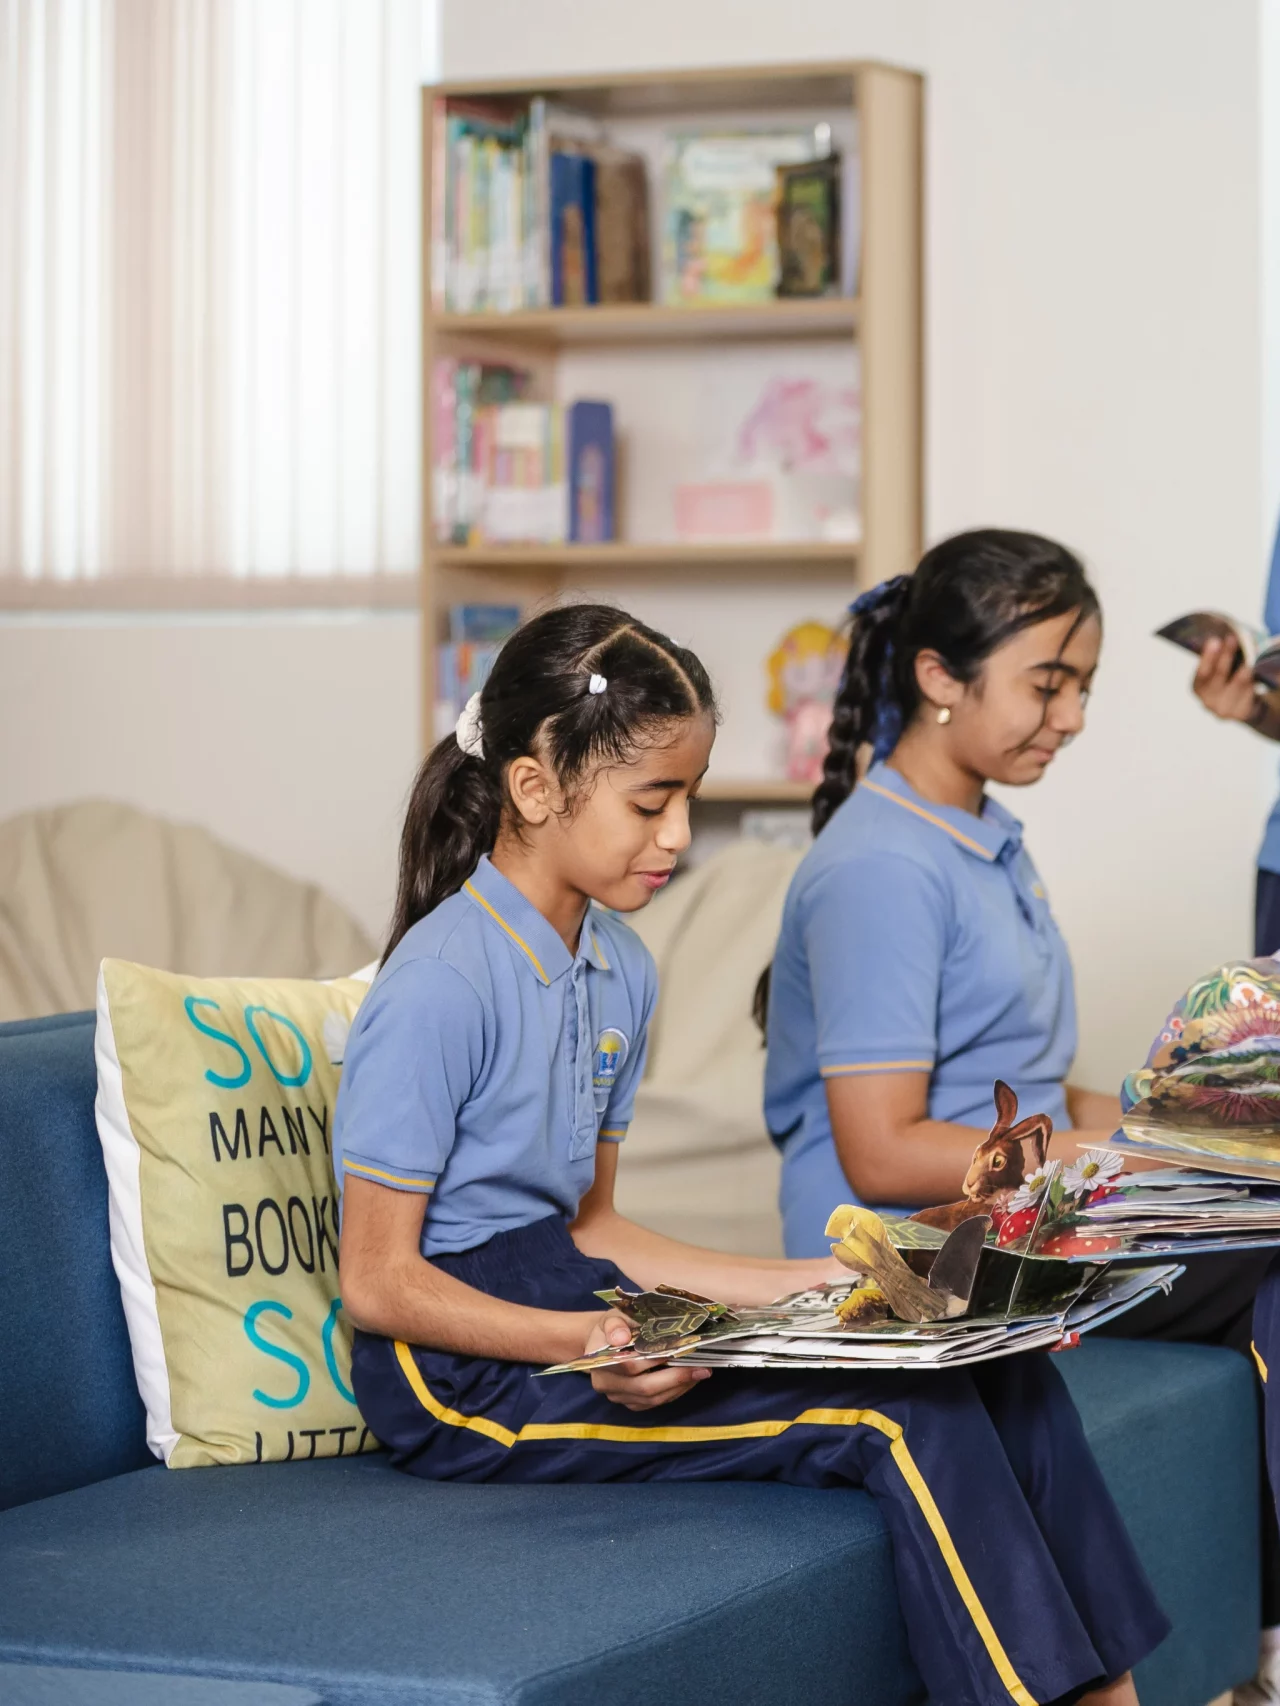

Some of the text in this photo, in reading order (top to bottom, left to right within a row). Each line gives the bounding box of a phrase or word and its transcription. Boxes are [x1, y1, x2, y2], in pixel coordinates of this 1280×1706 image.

[183, 994, 314, 1090] SO
[208, 1105, 330, 1162] MANY
[222, 1195, 340, 1279] BOOK
